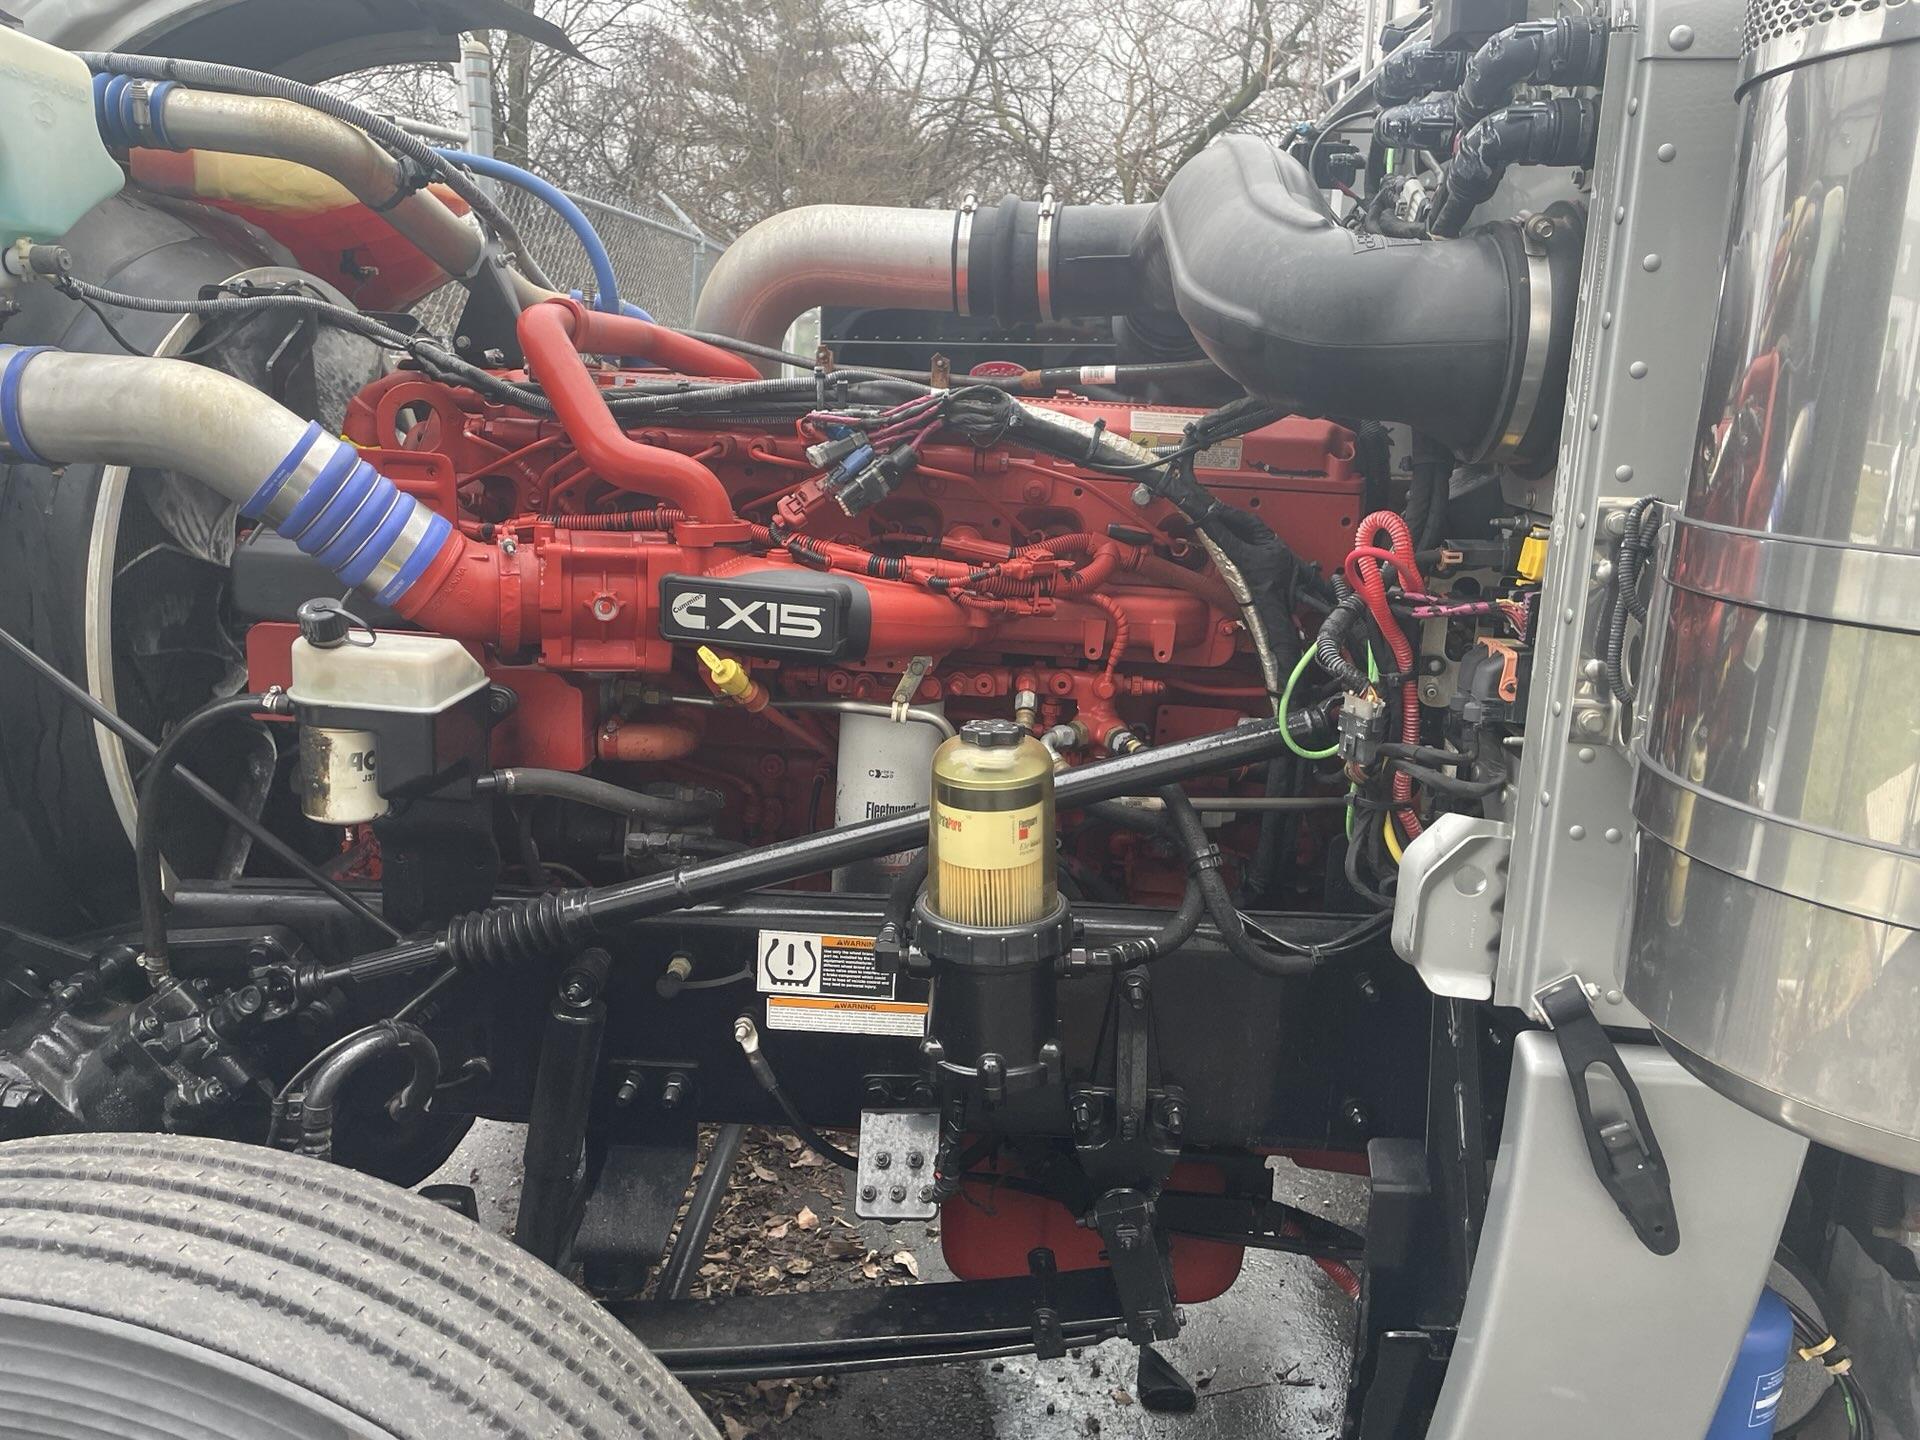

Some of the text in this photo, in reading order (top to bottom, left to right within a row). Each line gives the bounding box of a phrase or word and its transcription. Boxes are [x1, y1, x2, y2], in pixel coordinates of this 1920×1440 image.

[673, 594, 704, 613] Cummins
[717, 598, 822, 638] X15
[866, 801, 917, 819] Fleet
[844, 940, 875, 948] WARNIN
[840, 1002, 877, 1011] WARNING
